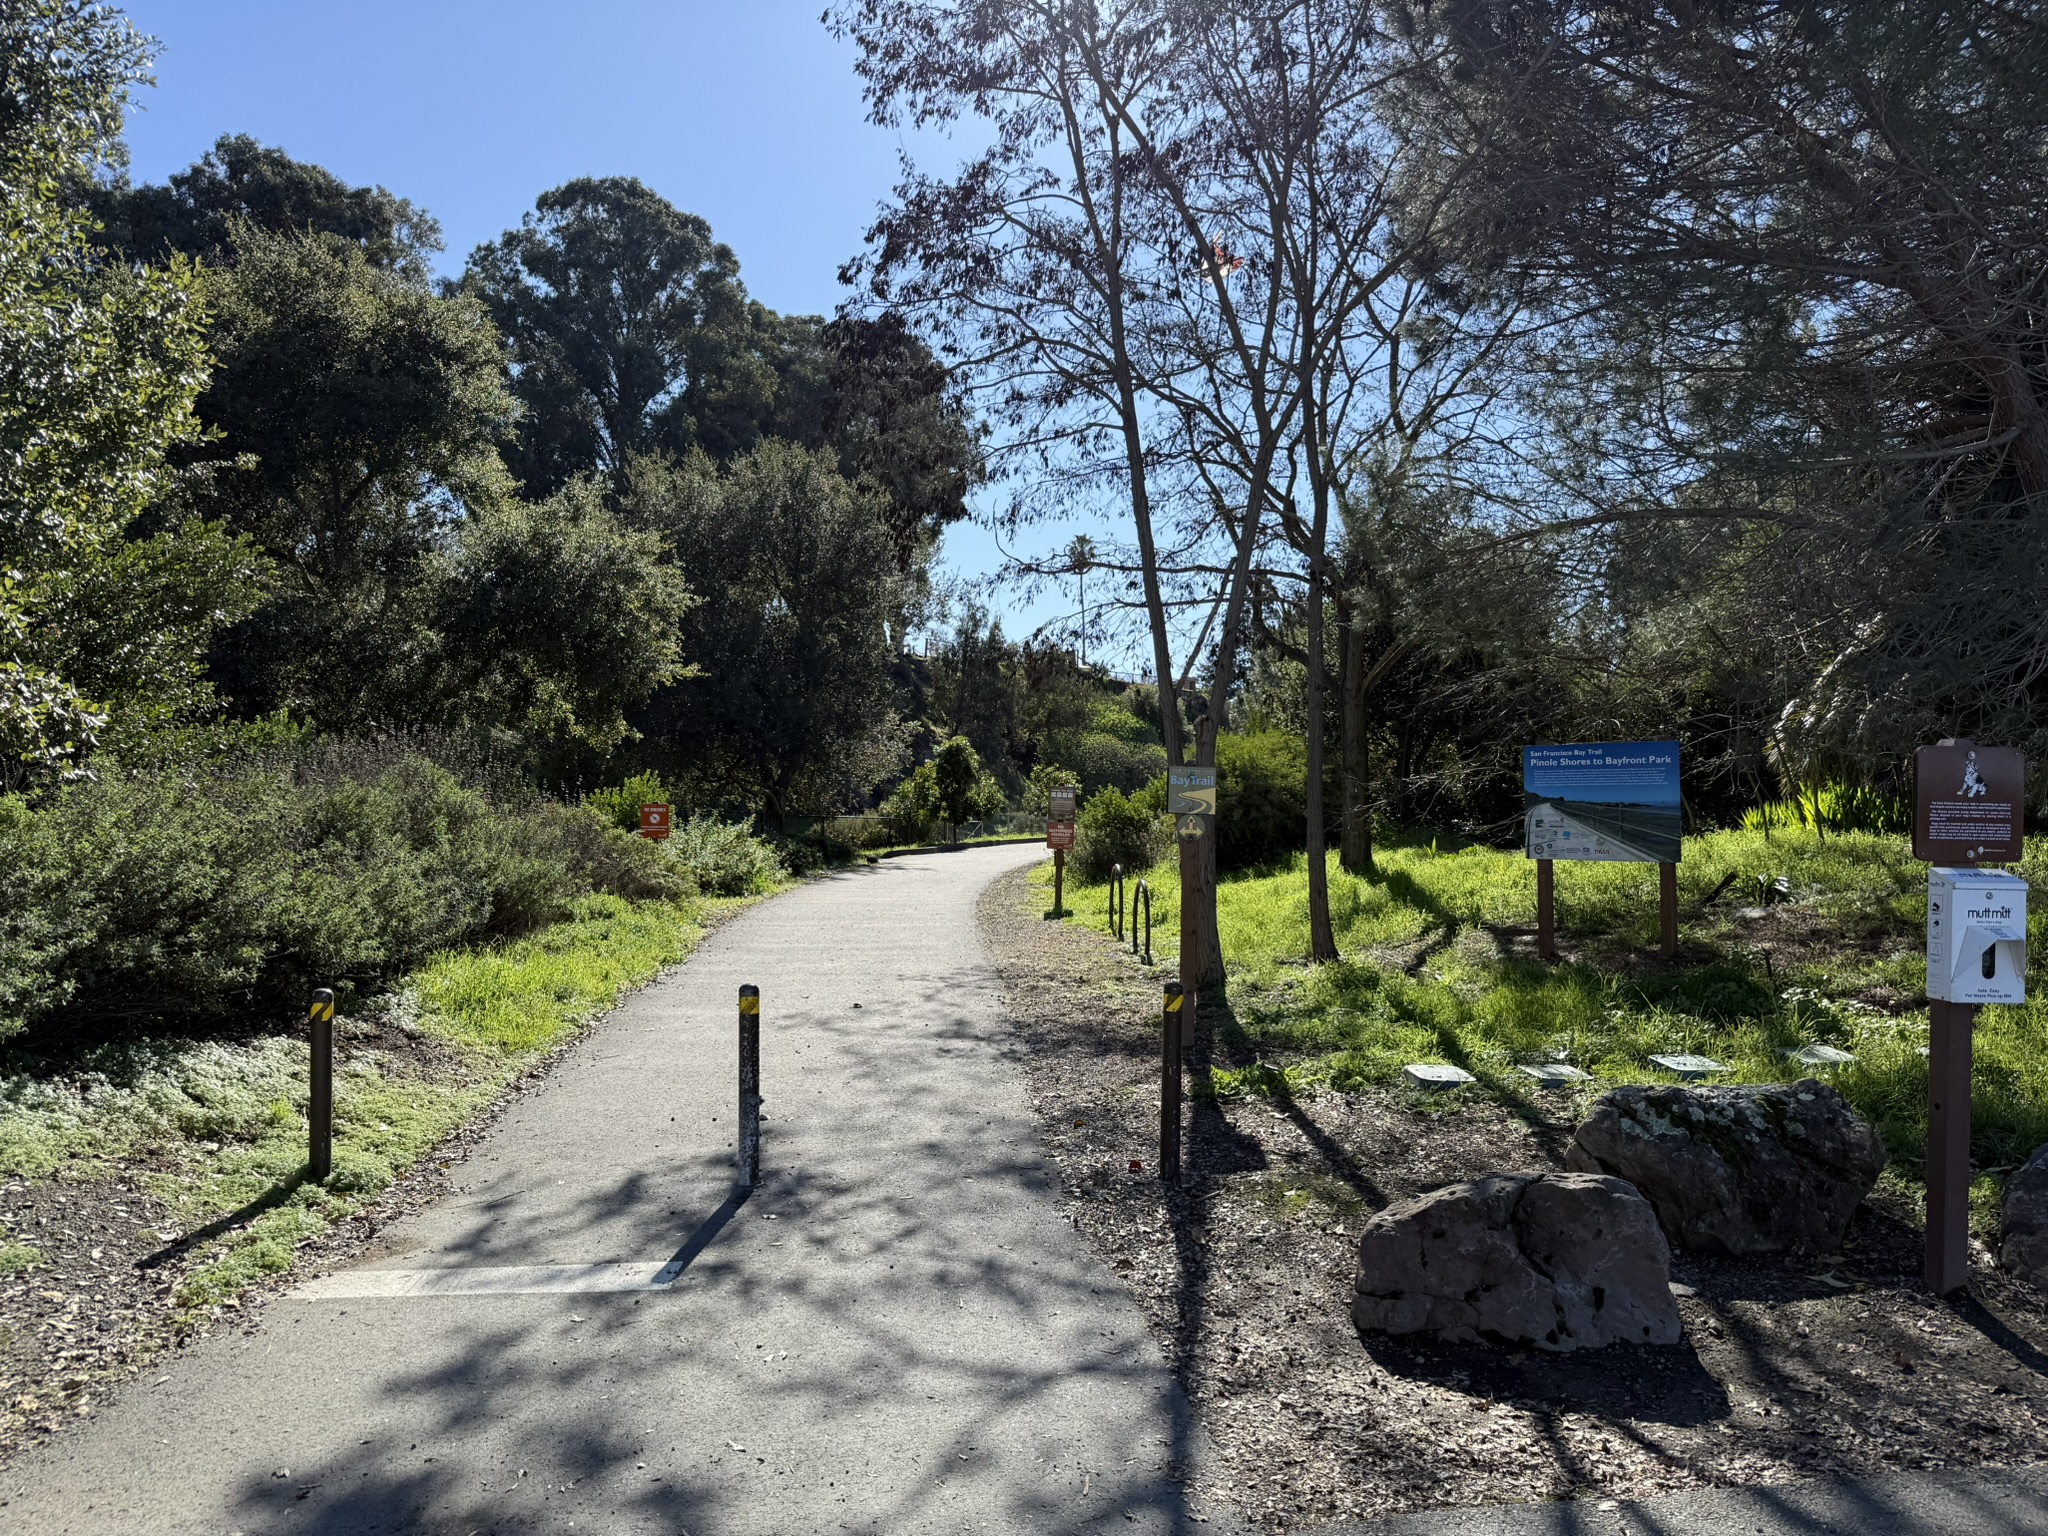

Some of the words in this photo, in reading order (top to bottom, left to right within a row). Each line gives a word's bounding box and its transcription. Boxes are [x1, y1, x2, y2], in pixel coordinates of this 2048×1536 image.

[1574, 749, 1586, 757] Bay
[1530, 758, 1558, 767] Pinole
[1560, 757, 1591, 766] Shores
[1605, 756, 1647, 767] Bayfront
[1648, 755, 1672, 764] Park
